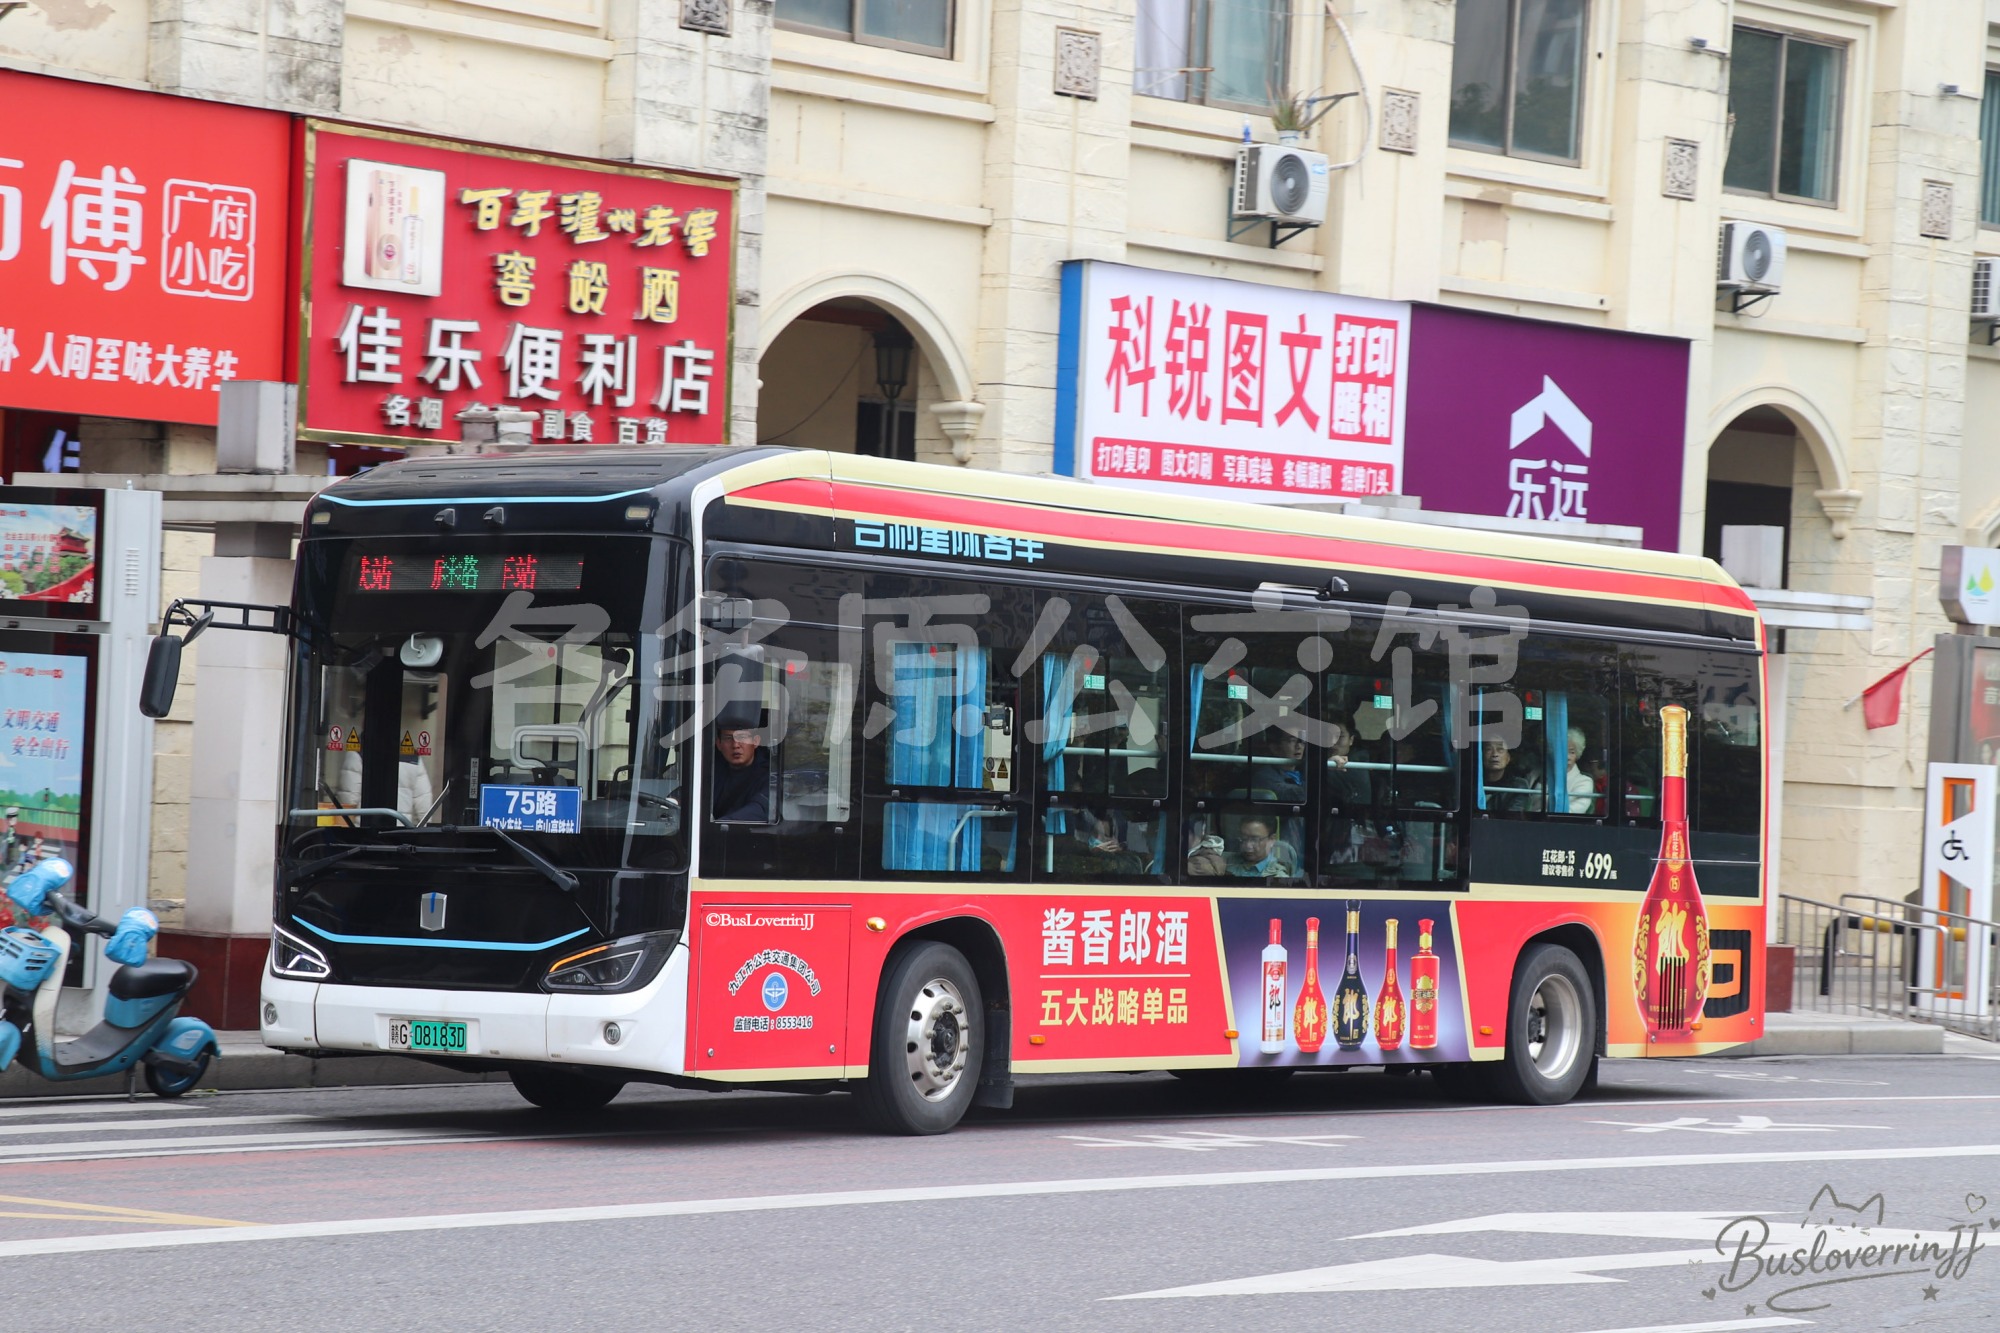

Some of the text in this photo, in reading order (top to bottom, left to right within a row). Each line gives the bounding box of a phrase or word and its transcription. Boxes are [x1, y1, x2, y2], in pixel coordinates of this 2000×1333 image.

[171, 191, 248, 241] 广府
[169, 241, 246, 291] 小吃
[495, 251, 680, 324] 窖龄酒
[31, 331, 239, 391] 人间至味大养生
[335, 304, 715, 416] 佳乐便利店
[1105, 294, 1323, 434] 科锐图文
[1335, 321, 1393, 378] 打印
[385, 395, 443, 430] 名烟
[542, 408, 595, 442] 副食
[617, 417, 669, 445] 百货
[1331, 381, 1392, 439] 照相
[1097, 442, 1151, 475] 打印复印
[1506, 458, 1589, 524] 乐远
[505, 790, 557, 817] 75路
[1041, 907, 1189, 966] 酱香郎酒
[728, 949, 822, 996] 九江市公共交通集团公司
[1039, 987, 1189, 1026] 五大战略单品
